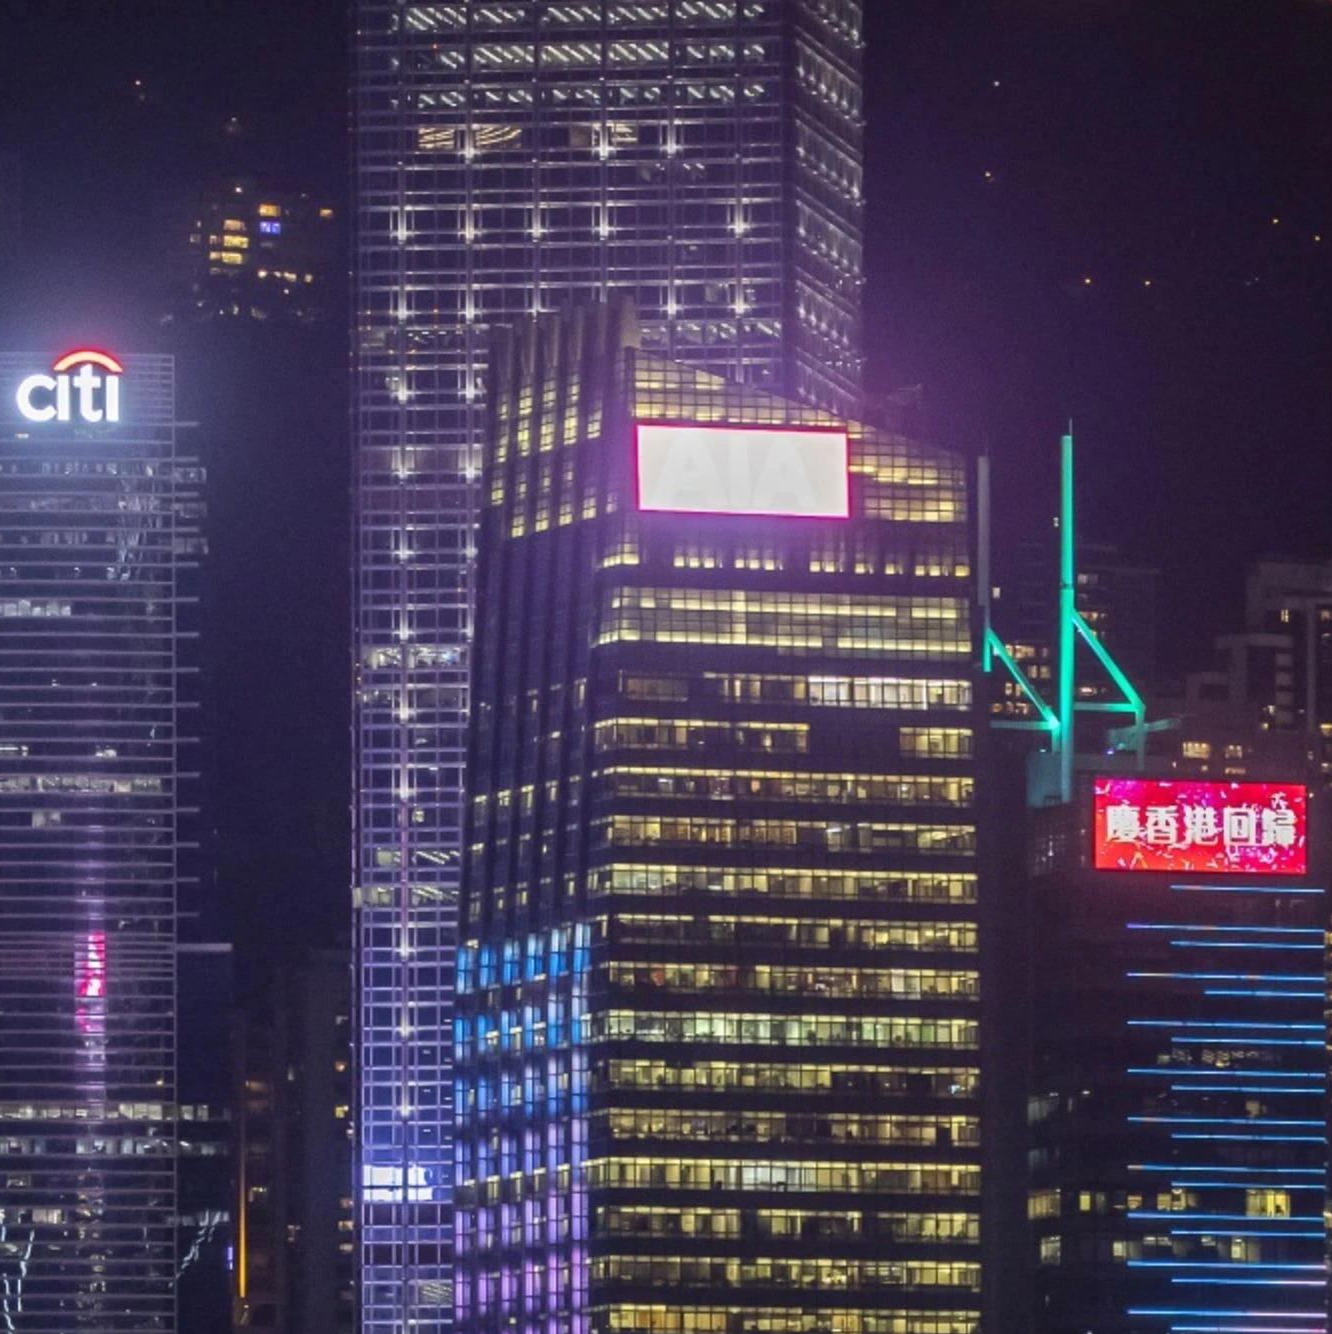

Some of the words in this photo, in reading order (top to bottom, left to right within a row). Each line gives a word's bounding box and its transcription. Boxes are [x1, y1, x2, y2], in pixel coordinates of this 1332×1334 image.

[15, 363, 120, 422] citi
[649, 429, 819, 510] AIA
[1105, 803, 1298, 848] 慶香港回歸
